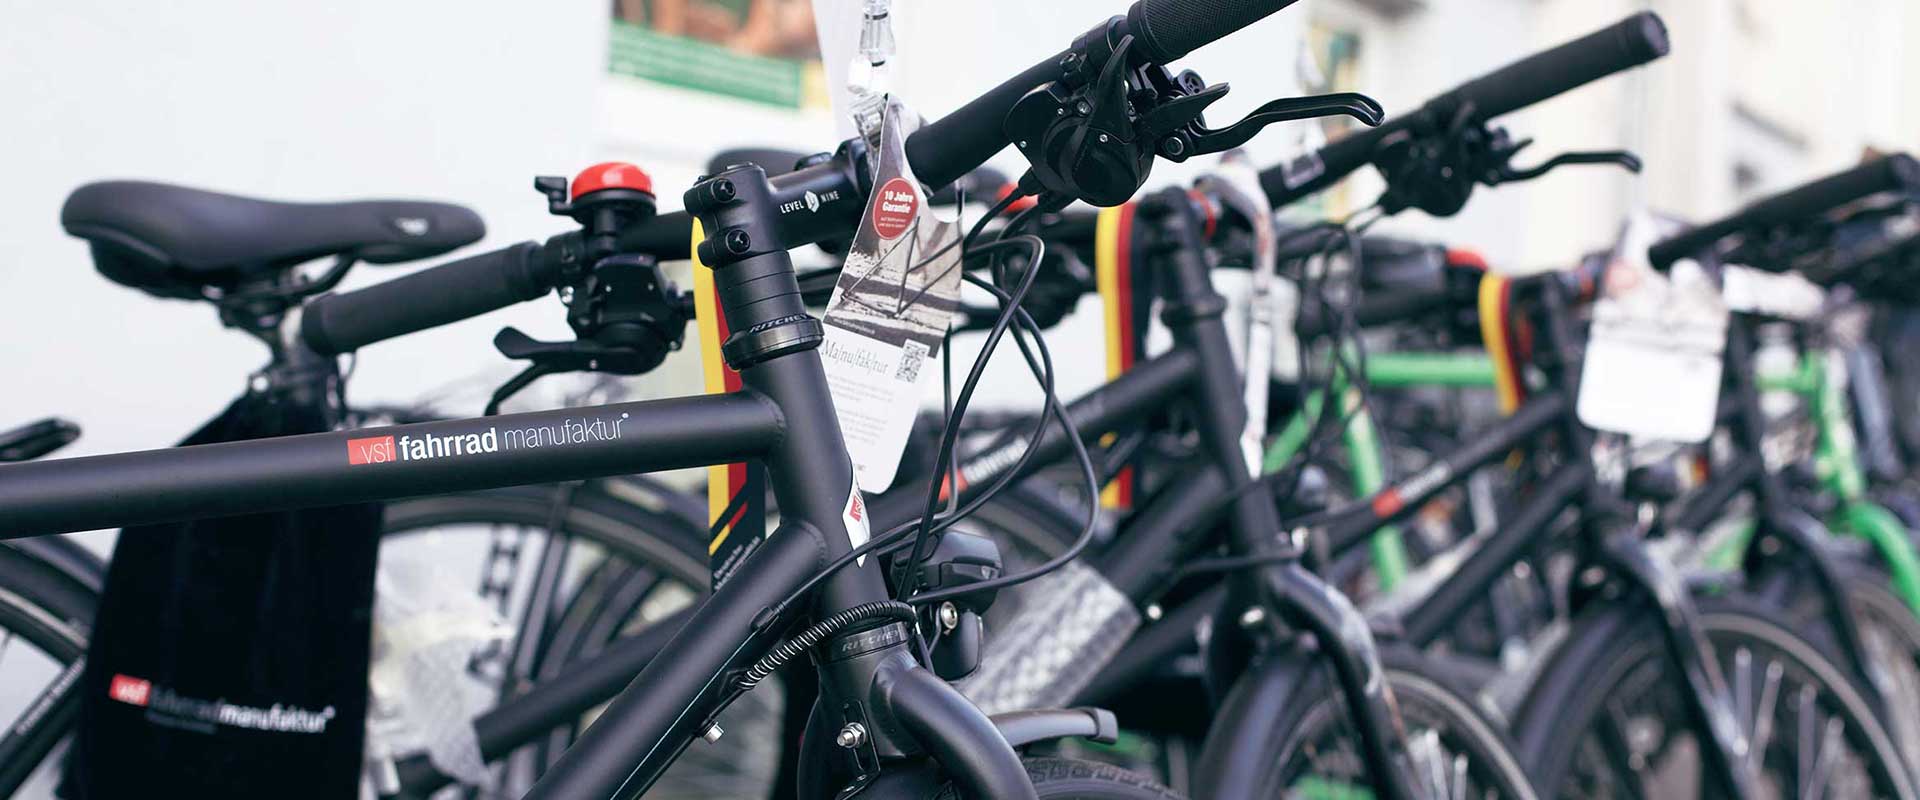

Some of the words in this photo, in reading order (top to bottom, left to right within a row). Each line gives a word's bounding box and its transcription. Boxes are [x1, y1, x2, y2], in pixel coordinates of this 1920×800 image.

[780, 200, 804, 213] LEVEL
[820, 190, 839, 202] NINE
[885, 190, 894, 201] 10
[894, 191, 914, 203] Jahre
[882, 201, 912, 213] Garantie
[749, 313, 809, 333] RITCHEY
[361, 437, 393, 464] vsf
[399, 427, 498, 461] fahrrad
[503, 416, 624, 450] manufaktur
